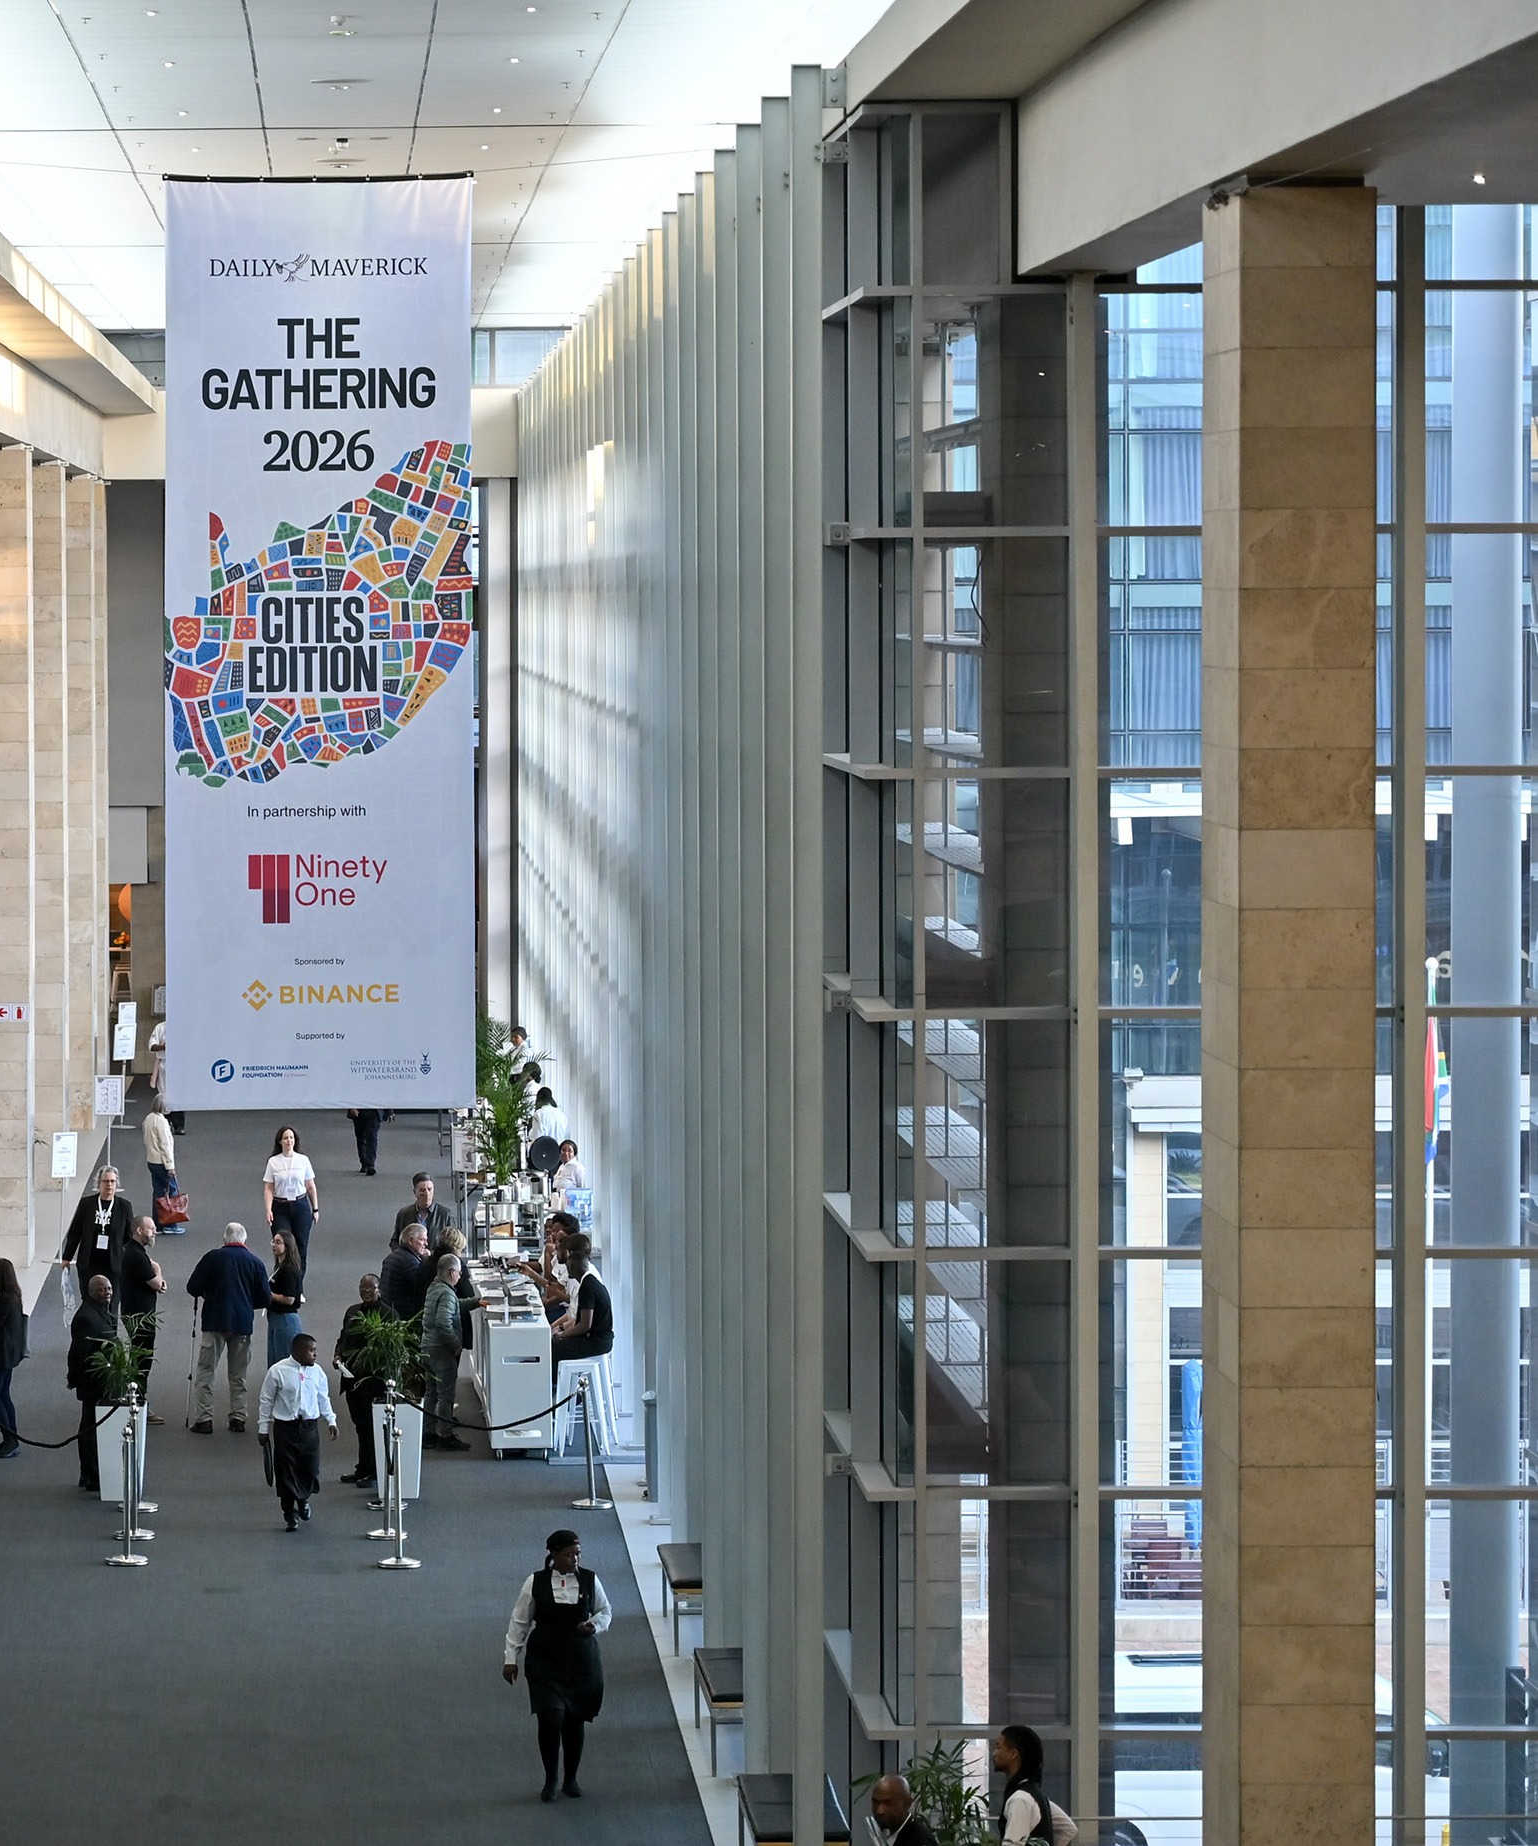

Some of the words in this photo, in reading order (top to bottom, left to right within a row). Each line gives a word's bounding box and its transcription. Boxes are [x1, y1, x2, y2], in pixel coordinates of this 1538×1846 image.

[209, 258, 276, 277] DAILY
[310, 256, 428, 277] MAVERICK
[277, 317, 360, 359] THE
[201, 367, 436, 410] GATHERING
[263, 429, 374, 472] 2026
[261, 596, 364, 644] CITIES
[248, 646, 377, 693] EDITION
[247, 805, 258, 818] In
[263, 805, 337, 820] partnership
[340, 805, 366, 817] with
[296, 854, 388, 884] Ninety
[295, 881, 356, 906] One
[294, 957, 334, 967] Sponsored
[335, 957, 345, 967] by
[280, 984, 399, 1005] BINANCE
[295, 1031, 335, 1041] Supported
[336, 1031, 345, 1041] by
